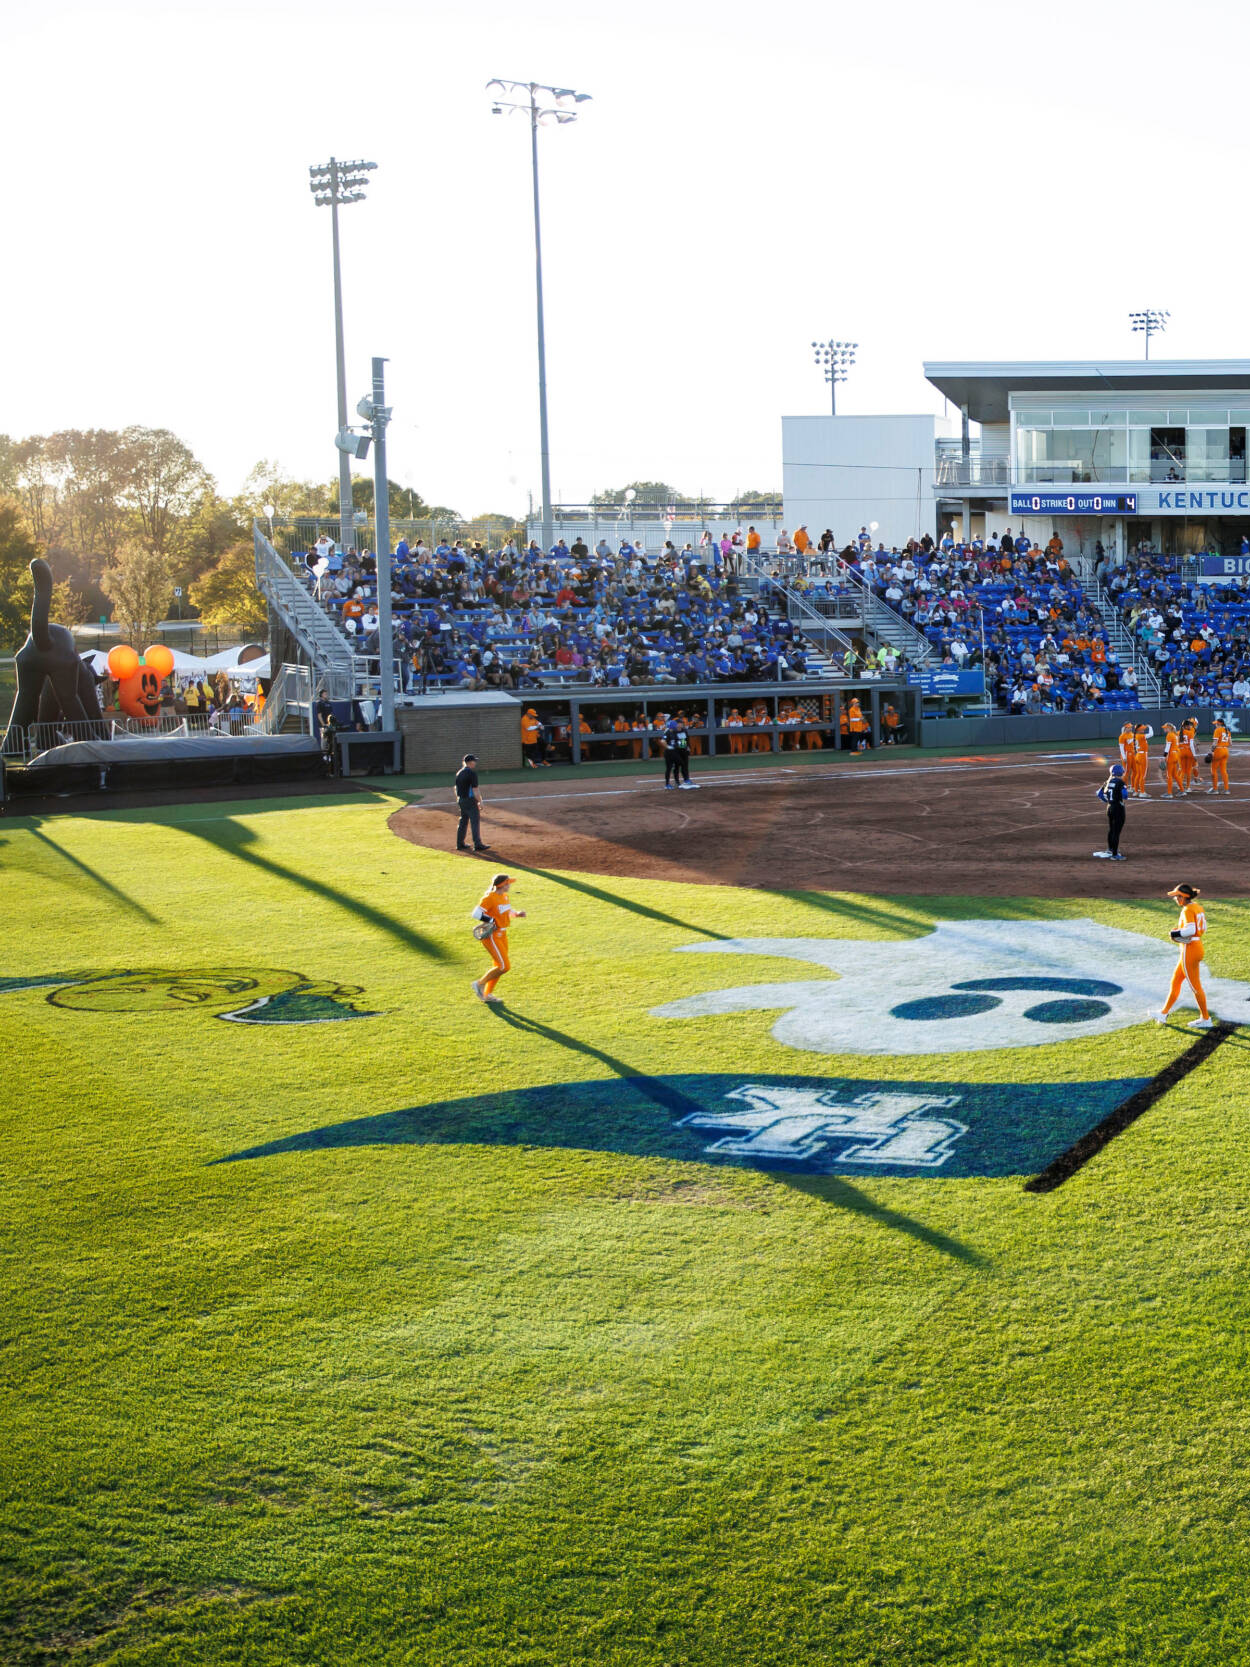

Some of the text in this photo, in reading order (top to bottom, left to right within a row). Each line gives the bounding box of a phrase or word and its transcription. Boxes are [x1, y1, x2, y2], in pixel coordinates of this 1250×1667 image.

[1012, 499, 1031, 508] BALL
[1041, 499, 1067, 508] STRIKE
[1078, 499, 1093, 508] OUT
[1103, 499, 1116, 508] INN
[1126, 497, 1135, 510] 4
